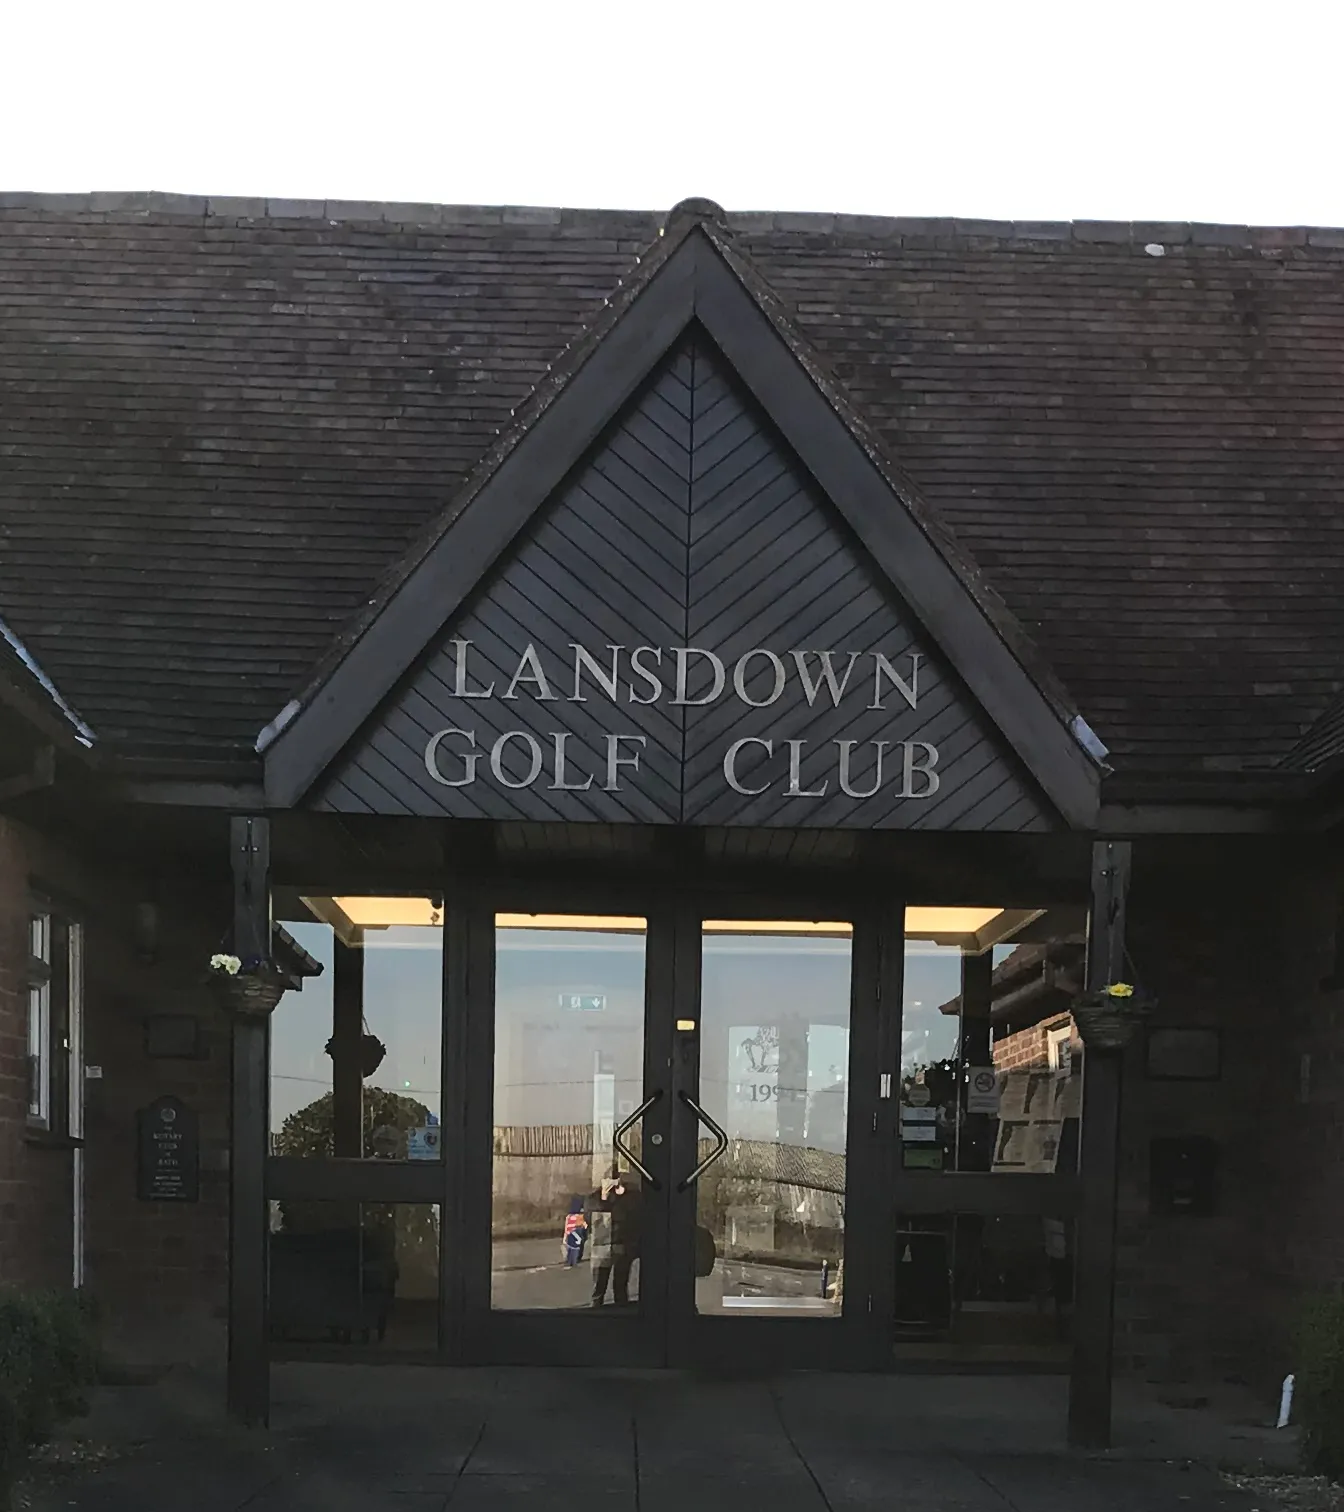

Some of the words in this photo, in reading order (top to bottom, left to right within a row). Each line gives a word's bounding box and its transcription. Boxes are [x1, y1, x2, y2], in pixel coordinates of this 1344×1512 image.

[449, 639, 923, 711] LANSDOWN
[424, 728, 647, 792] GOLF
[723, 736, 942, 798] CLUB
